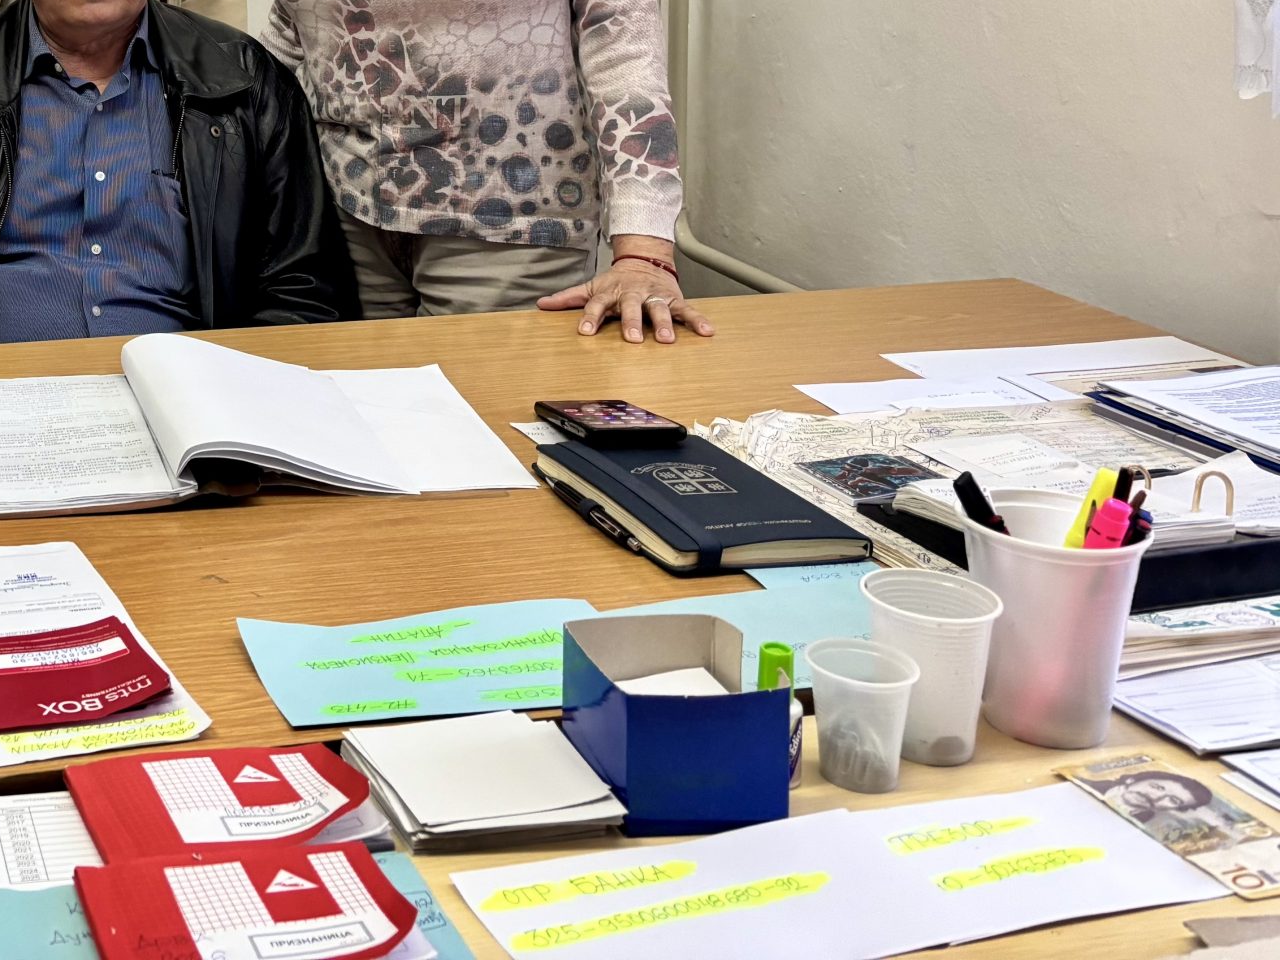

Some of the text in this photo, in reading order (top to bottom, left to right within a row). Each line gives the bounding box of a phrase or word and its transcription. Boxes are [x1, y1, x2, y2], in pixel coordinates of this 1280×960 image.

[37, 677, 152, 716] mts BOX
[239, 813, 312, 828] ПРИЗНАНИЦА
[569, 865, 673, 895] БАНКА
[1222, 864, 1265, 890] 10
[270, 930, 354, 949] ПРИЗНАНИЦА
